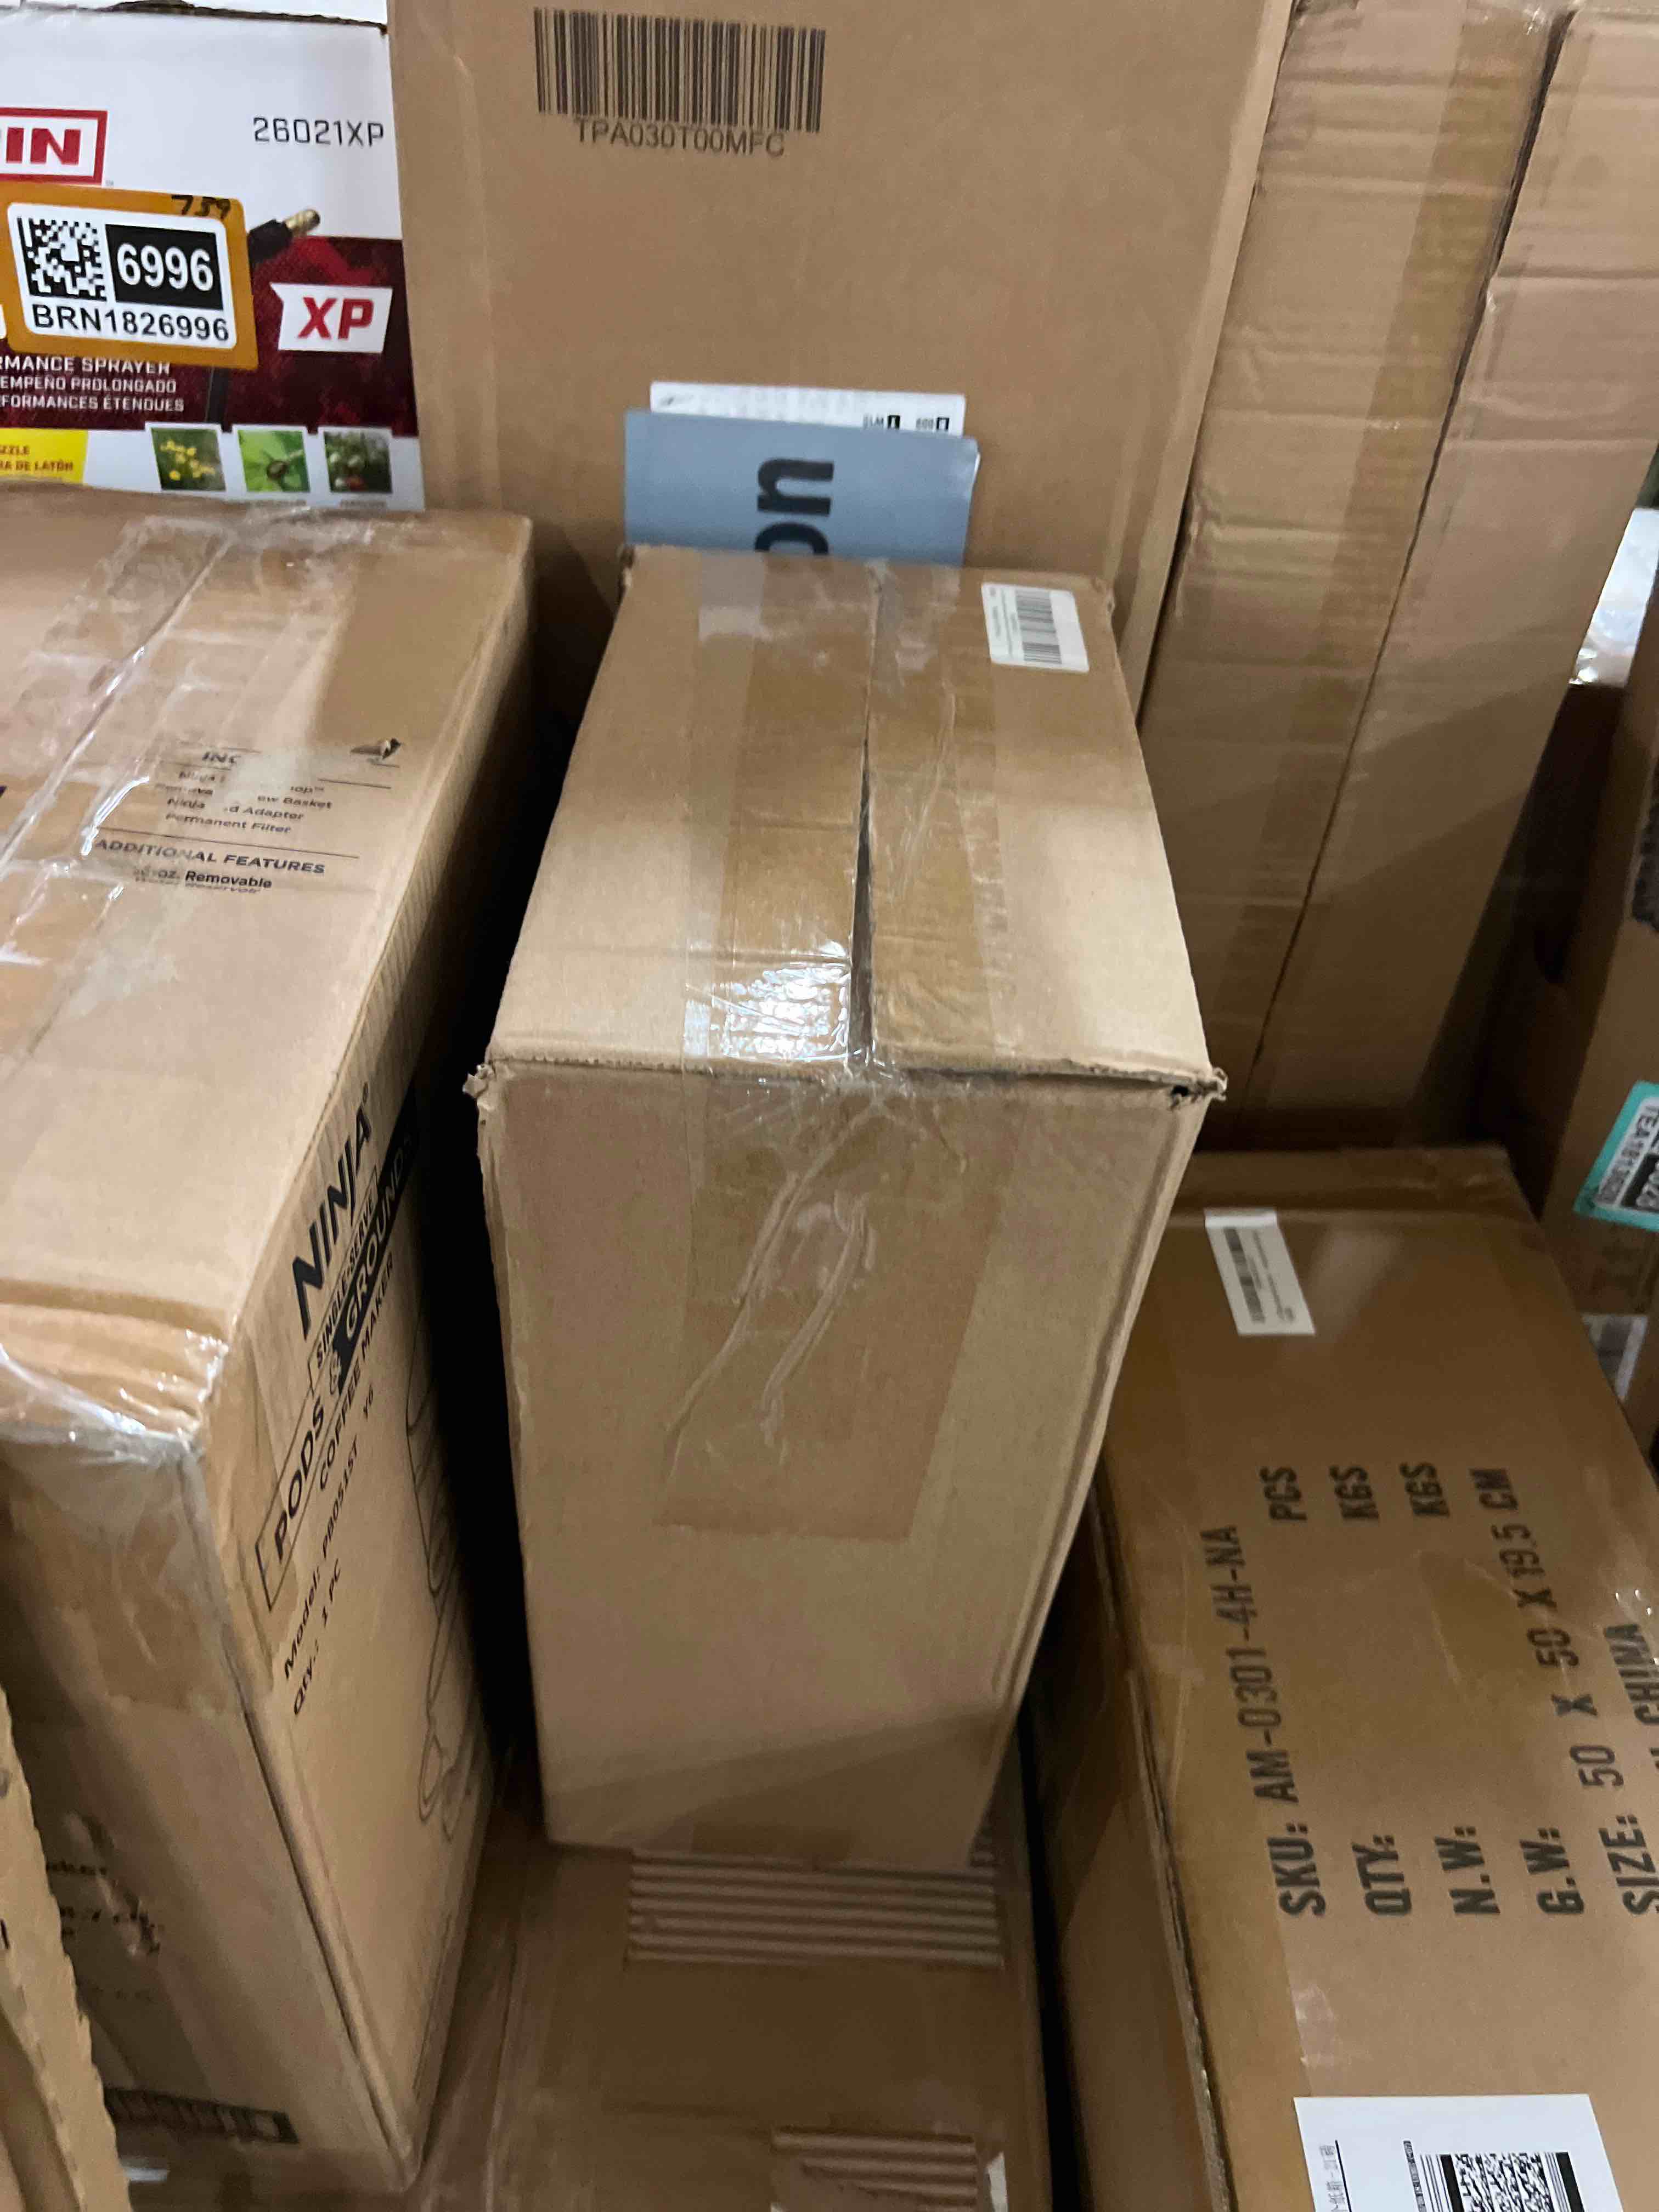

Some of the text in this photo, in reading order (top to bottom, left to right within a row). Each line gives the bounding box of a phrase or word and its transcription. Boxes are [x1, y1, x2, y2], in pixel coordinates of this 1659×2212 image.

[252, 116, 384, 147] 26021XP
[117, 242, 214, 292] 6996
[32, 303, 229, 342] BRN1826996
[297, 297, 375, 340] XP
[71, 377, 177, 393] PROLONGADO
[165, 813, 246, 830] Permanent
[242, 807, 305, 820] Adapter
[283, 797, 332, 809] Basket
[95, 839, 325, 874] ADDITIONAL FEATURES
[185, 870, 273, 889] Removable
[292, 1105, 373, 1342] NINJA
[320, 1251, 393, 1491] COFFEE MAKER
[275, 1395, 324, 1562] PODS
[329, 1559, 340, 1602] PC
[285, 1566, 320, 1680] Model:
[1527, 1628, 1579, 1667] 50
[1260, 1466, 1412, 1915] QTY: PCS
[1329, 1465, 1500, 1914] N.W: KGS
[1400, 1462, 1584, 1914] G.W: KGS
[1200, 1525, 1326, 1915] SKU: AM-0301-4H-NA
[1570, 1745, 1624, 1787] 50
[1598, 1815, 1659, 1914] SIZE:
